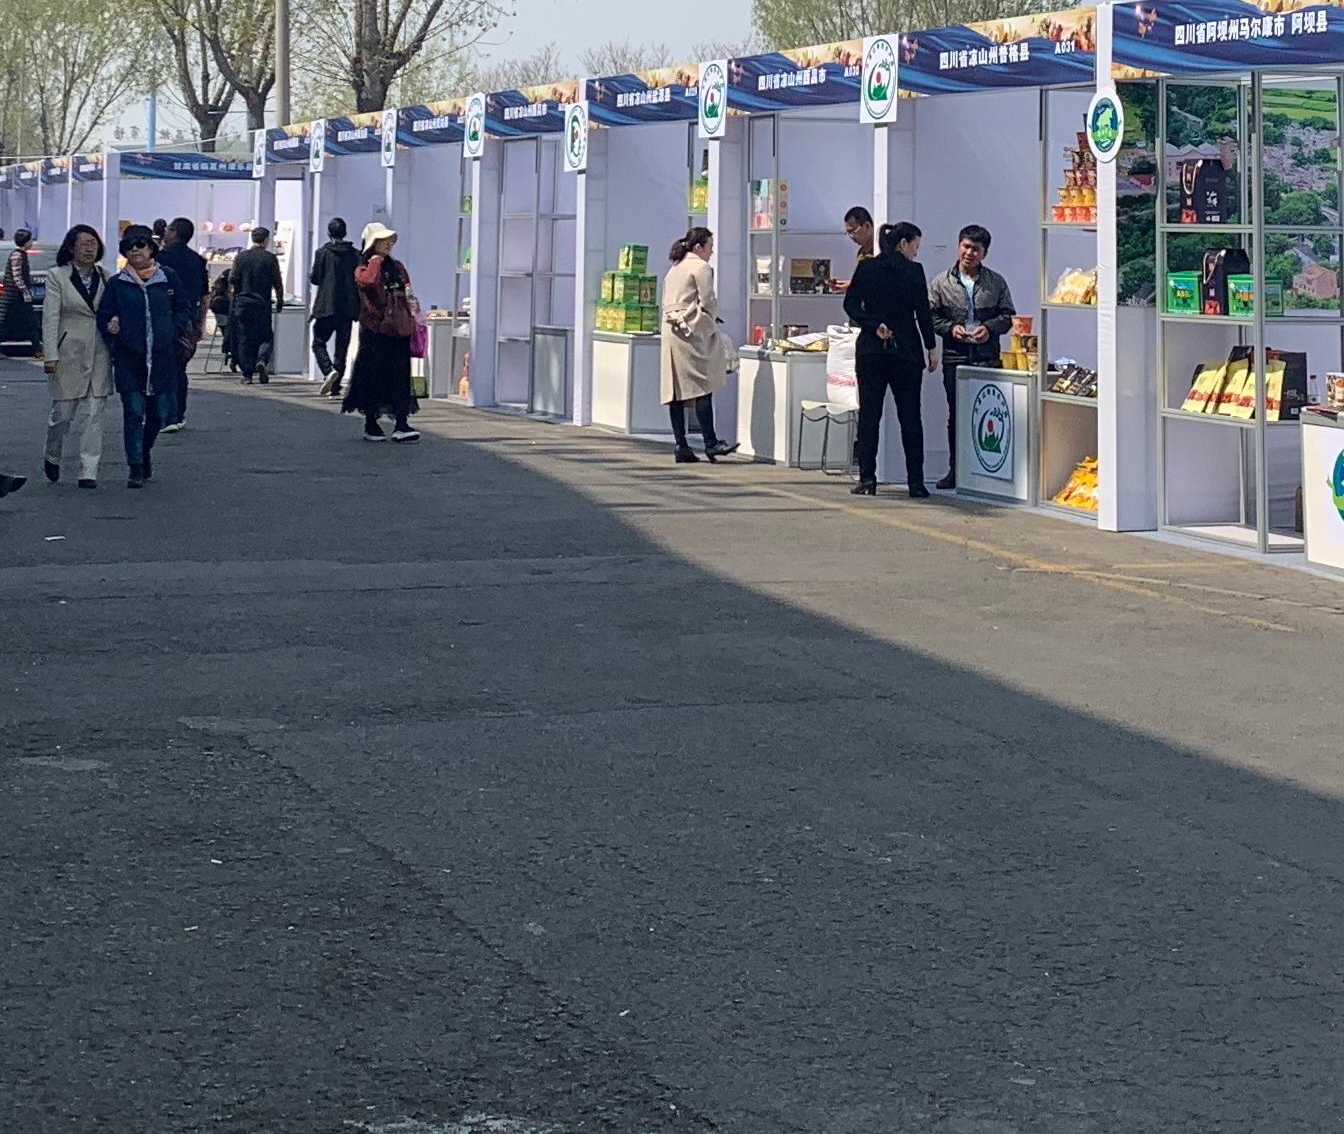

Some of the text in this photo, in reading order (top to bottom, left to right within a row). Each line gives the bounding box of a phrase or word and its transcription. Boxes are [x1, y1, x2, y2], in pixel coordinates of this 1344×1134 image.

[1174, 13, 1286, 46] 四川省阿坝州马尔康市
[1291, 10, 1328, 35] 阿坝县
[939, 41, 1076, 70] 四川省凉山州普格县 A031
[758, 68, 827, 91] 四川省凉山州西昌市
